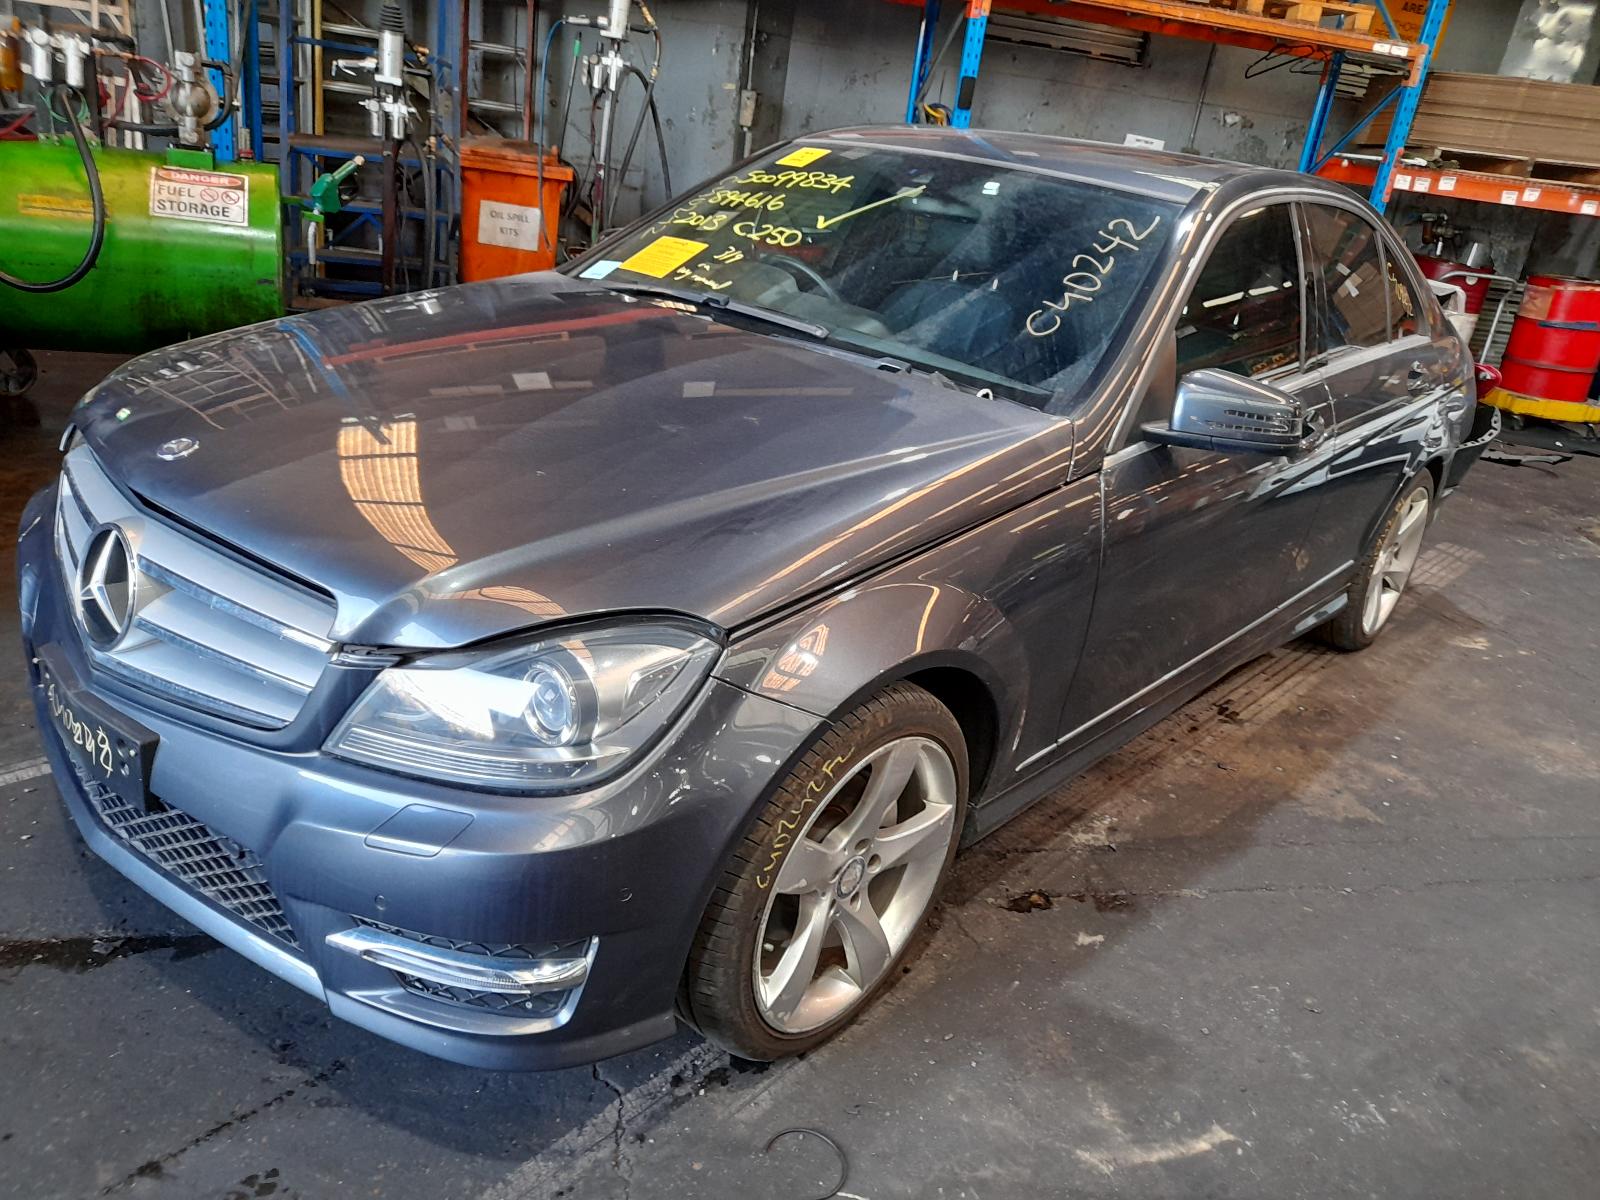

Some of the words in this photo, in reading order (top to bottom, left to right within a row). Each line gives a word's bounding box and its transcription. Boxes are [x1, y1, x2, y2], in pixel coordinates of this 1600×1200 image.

[1401, 1, 1427, 15] ARE
[170, 171, 229, 185] DANGER
[157, 184, 195, 198] FUEL
[157, 199, 230, 218] STORAGE
[490, 210, 504, 220] OIL
[506, 213, 530, 223] SPILL
[499, 227, 519, 237] KITS
[733, 221, 803, 247] C250
